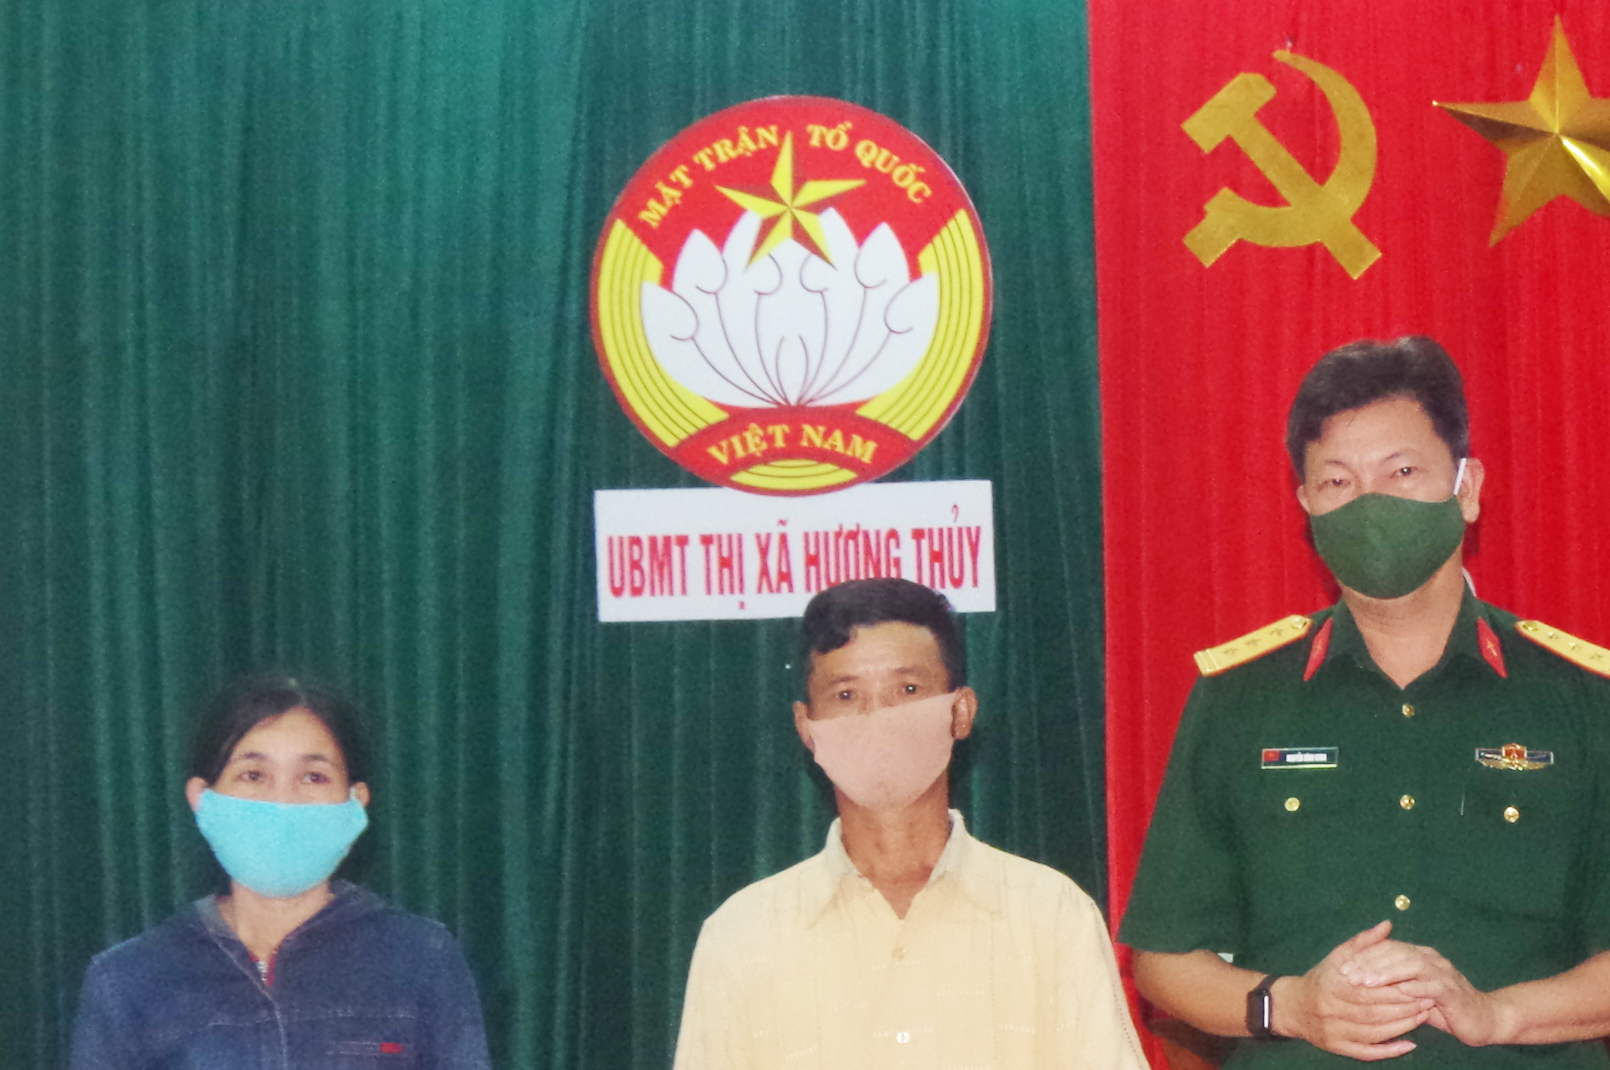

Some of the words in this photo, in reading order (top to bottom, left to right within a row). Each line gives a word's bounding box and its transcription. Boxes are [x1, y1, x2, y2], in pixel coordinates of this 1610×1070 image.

[638, 168, 694, 229] MẶT
[693, 124, 781, 172] TRẬN
[807, 121, 850, 152] TỔ
[855, 138, 933, 204] QUỐC
[705, 423, 790, 467] VIỆT
[802, 423, 878, 464] NAM
[607, 533, 689, 598] UBMT
[700, 532, 746, 609] THỊ
[755, 519, 795, 594] XÃ
[910, 503, 981, 590] THỦY
